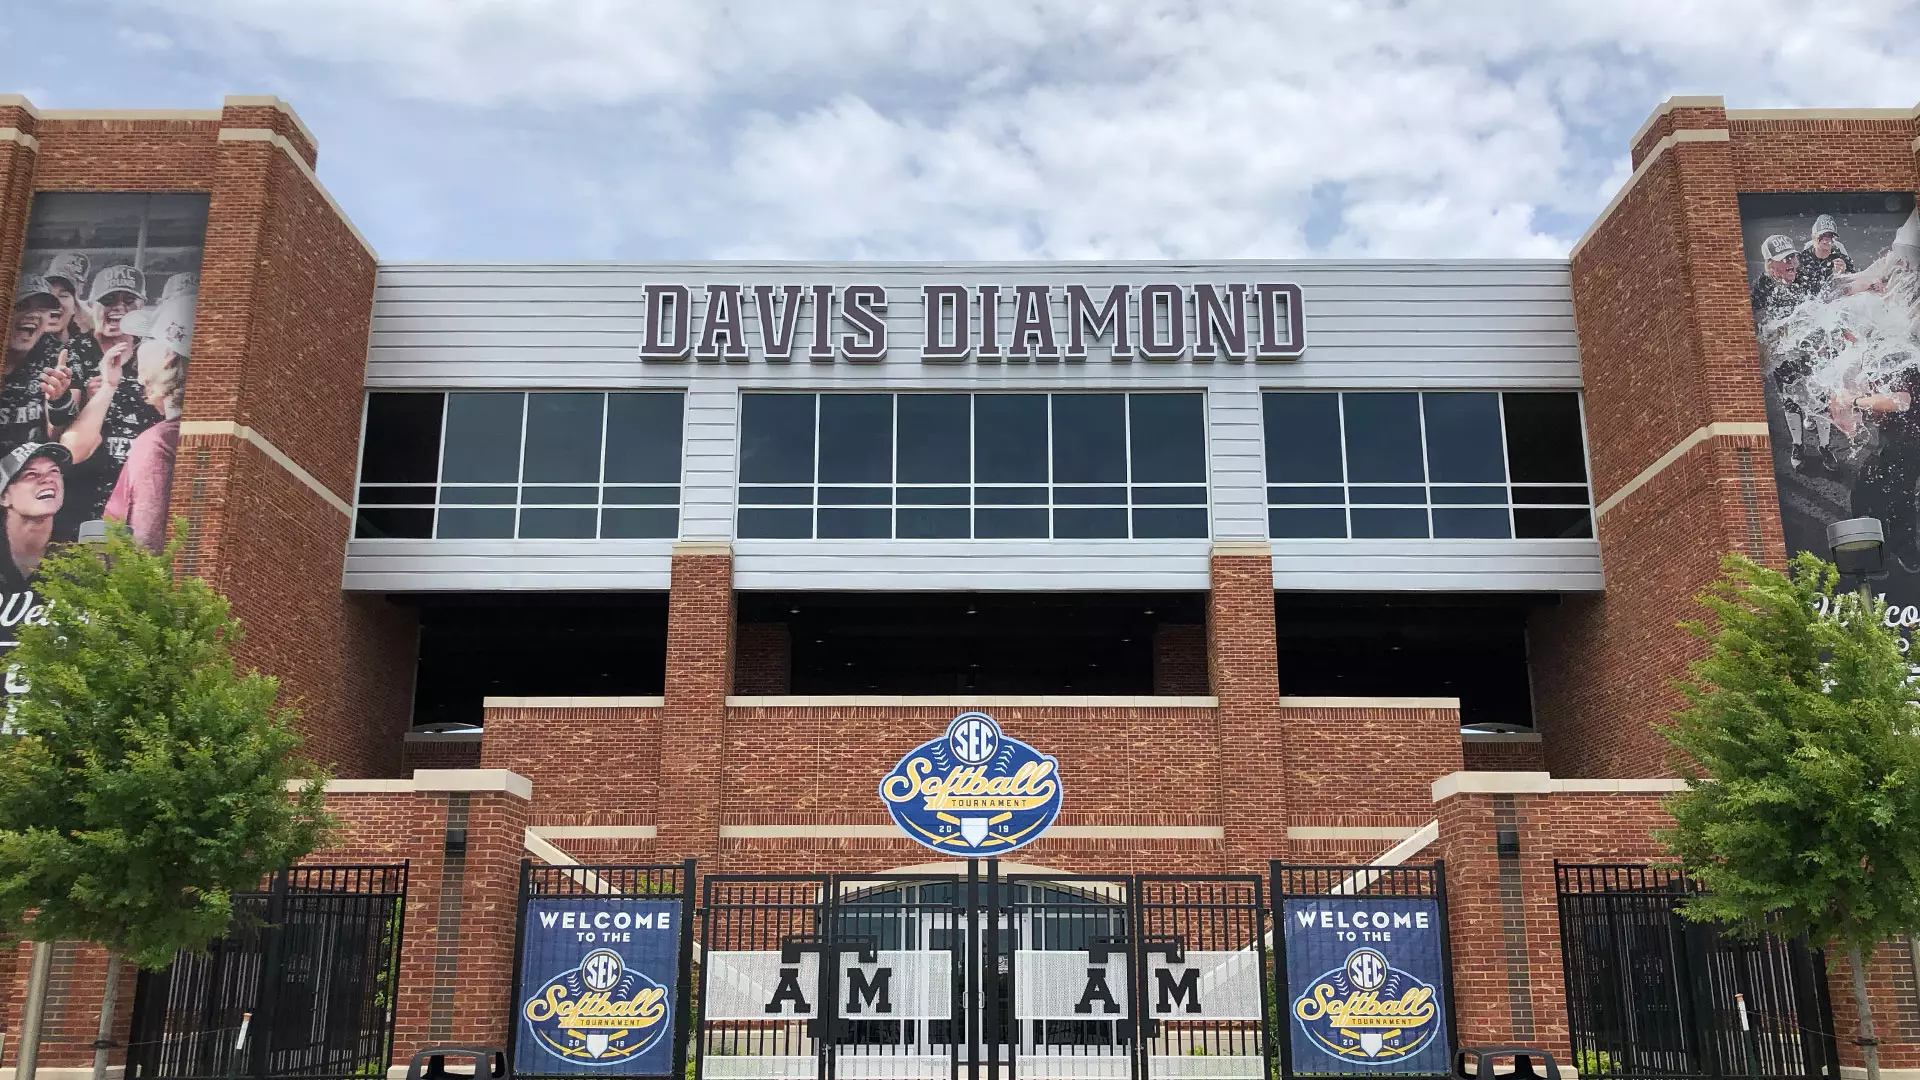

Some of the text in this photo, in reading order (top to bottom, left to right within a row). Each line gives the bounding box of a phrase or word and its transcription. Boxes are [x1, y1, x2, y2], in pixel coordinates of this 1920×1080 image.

[638, 282, 1307, 362] DAVIS DIAMOND
[954, 720, 994, 762] SEC
[883, 757, 1057, 809] Softball
[952, 799, 1027, 807] TOURNAMENT
[938, 825, 952, 833] 20
[540, 912, 670, 928] WELCOME
[1297, 911, 1429, 928] WELCOME
[1337, 931, 1391, 941] TO THE
[577, 932, 631, 942] TO THE
[585, 955, 618, 989] SEC
[1351, 954, 1383, 989] SEC
[526, 984, 665, 1024] Softball
[1297, 984, 1435, 1026] Softball
